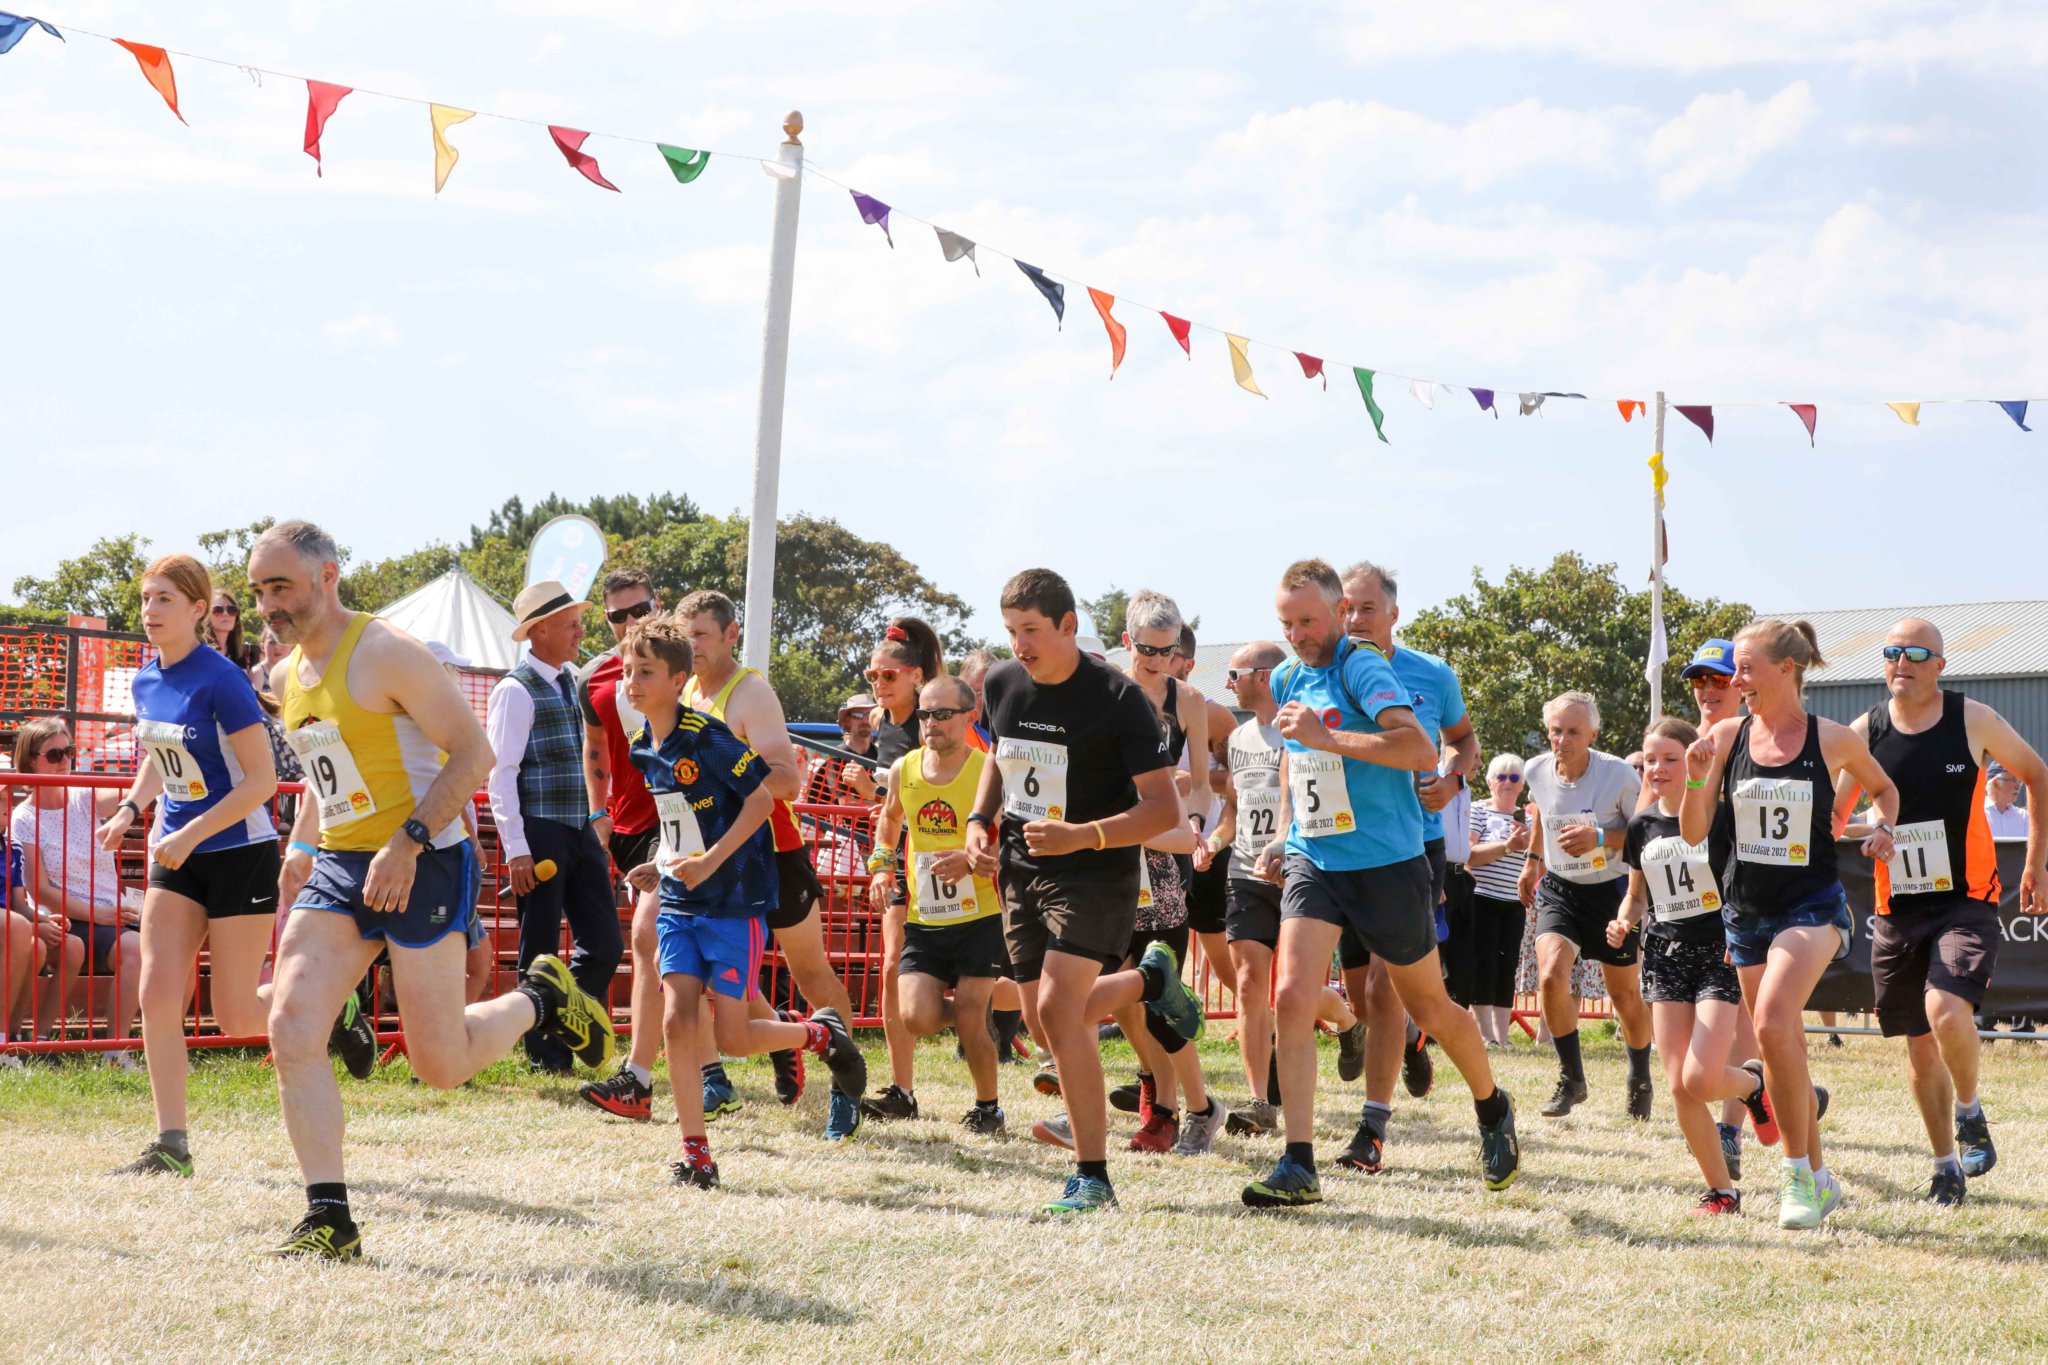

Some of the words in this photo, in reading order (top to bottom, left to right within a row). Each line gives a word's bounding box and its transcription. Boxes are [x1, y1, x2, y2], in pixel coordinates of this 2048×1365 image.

[1018, 721, 1066, 733] KOOGA
[155, 747, 182, 778] 10
[1946, 764, 1966, 773] SMP
[311, 755, 337, 799] 19
[1024, 766, 1040, 798] 6
[1307, 779, 1320, 813] 5
[1033, 805, 1047, 816] 2022
[1250, 808, 1276, 836] 22
[1319, 818, 1334, 829] 2022
[1759, 806, 1789, 840] 13
[662, 820, 681, 852] 17
[1750, 844, 1770, 857] LEAGUE
[1772, 846, 1787, 857] 2022
[1563, 863, 1579, 871] LEAGUE
[1902, 847, 1927, 878] 11
[1664, 861, 1695, 896] 14
[1920, 882, 1934, 891] 2022
[919, 906, 929, 915] FELL
[930, 904, 947, 914] LEAGUE
[948, 903, 960, 912] 2022
[1656, 903, 1666, 913] FELL
[1666, 901, 1685, 912] LEAGUE
[1686, 898, 1701, 910] 2022
